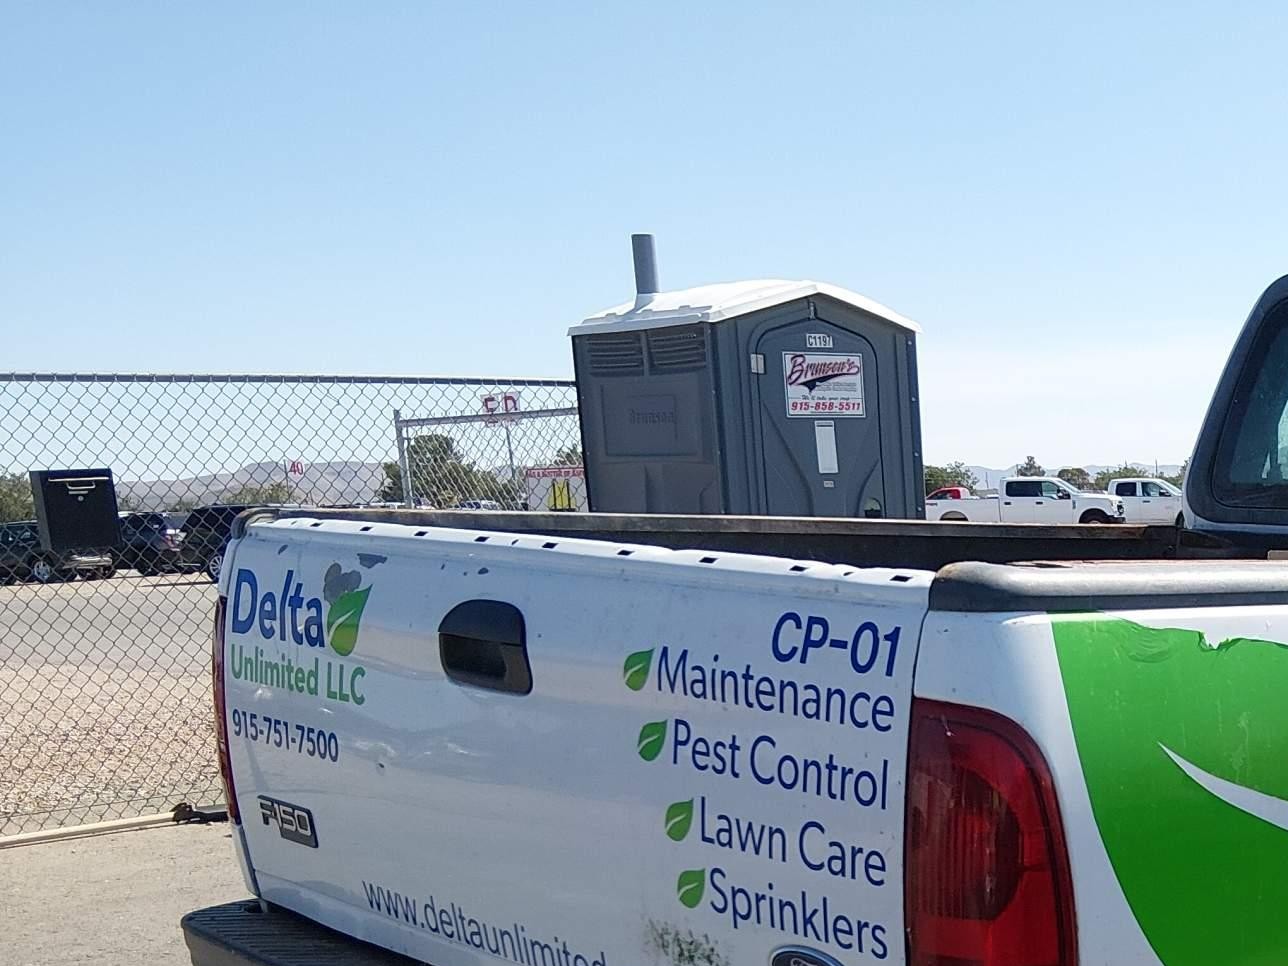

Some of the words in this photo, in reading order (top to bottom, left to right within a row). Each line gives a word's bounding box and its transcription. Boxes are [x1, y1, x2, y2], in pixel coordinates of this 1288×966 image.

[807, 335, 832, 347] C1197
[791, 401, 861, 411] 915-858-5511
[231, 568, 326, 648] Delta
[772, 611, 901, 677] CP-01
[231, 644, 319, 697] Unlimited
[326, 662, 366, 706] LLC
[657, 646, 895, 732] Maintenance
[232, 708, 339, 763] 915-751-7500
[673, 718, 741, 778] Pest
[750, 735, 888, 810] Control
[700, 796, 787, 862] Lawn
[799, 821, 886, 886] Care
[709, 867, 888, 960] Sprinklers
